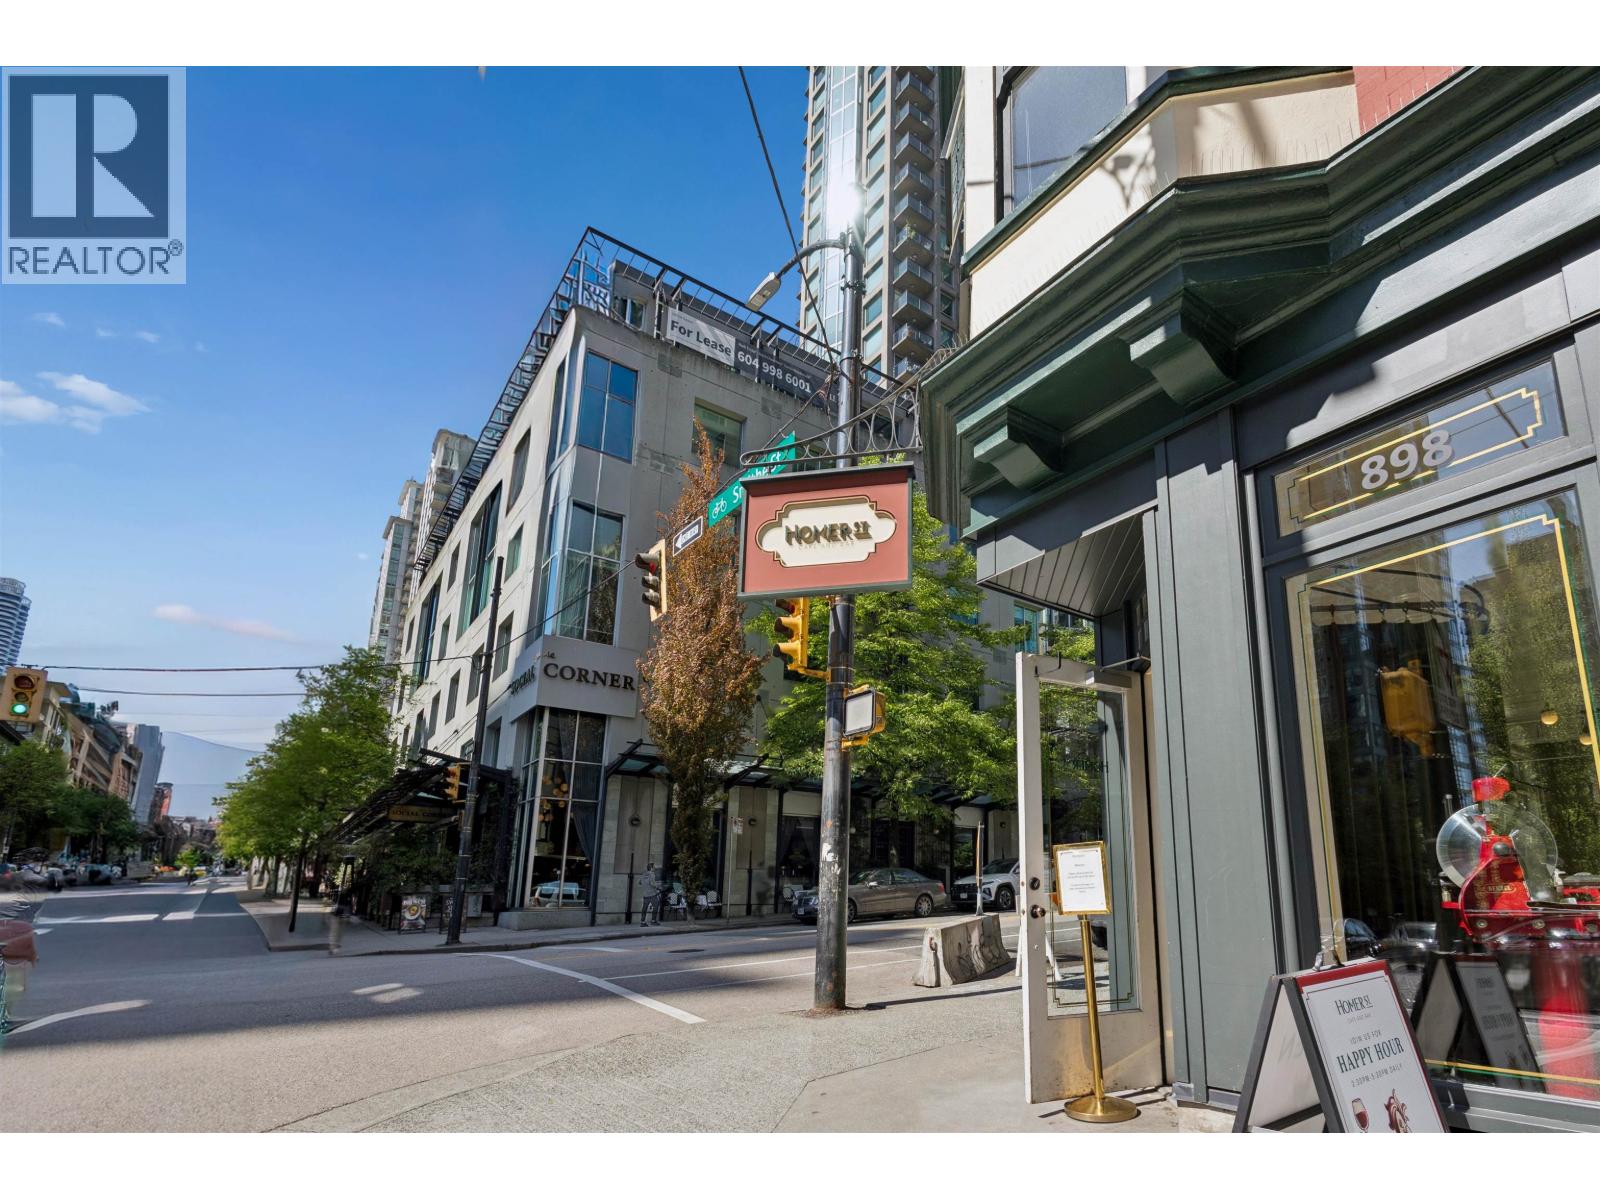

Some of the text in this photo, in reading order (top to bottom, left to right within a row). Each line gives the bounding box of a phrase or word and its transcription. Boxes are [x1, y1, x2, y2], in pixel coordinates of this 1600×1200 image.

[670, 320, 732, 357] For Lease
[737, 351, 759, 368] 604
[762, 362, 783, 380] 998
[785, 373, 812, 393] 6001
[1361, 430, 1452, 490] 898
[785, 522, 853, 546] HOMER
[543, 662, 636, 691] CORNER
[1335, 995, 1365, 1015] HOMER
[1336, 1037, 1404, 1073] HAPPY HOUR
